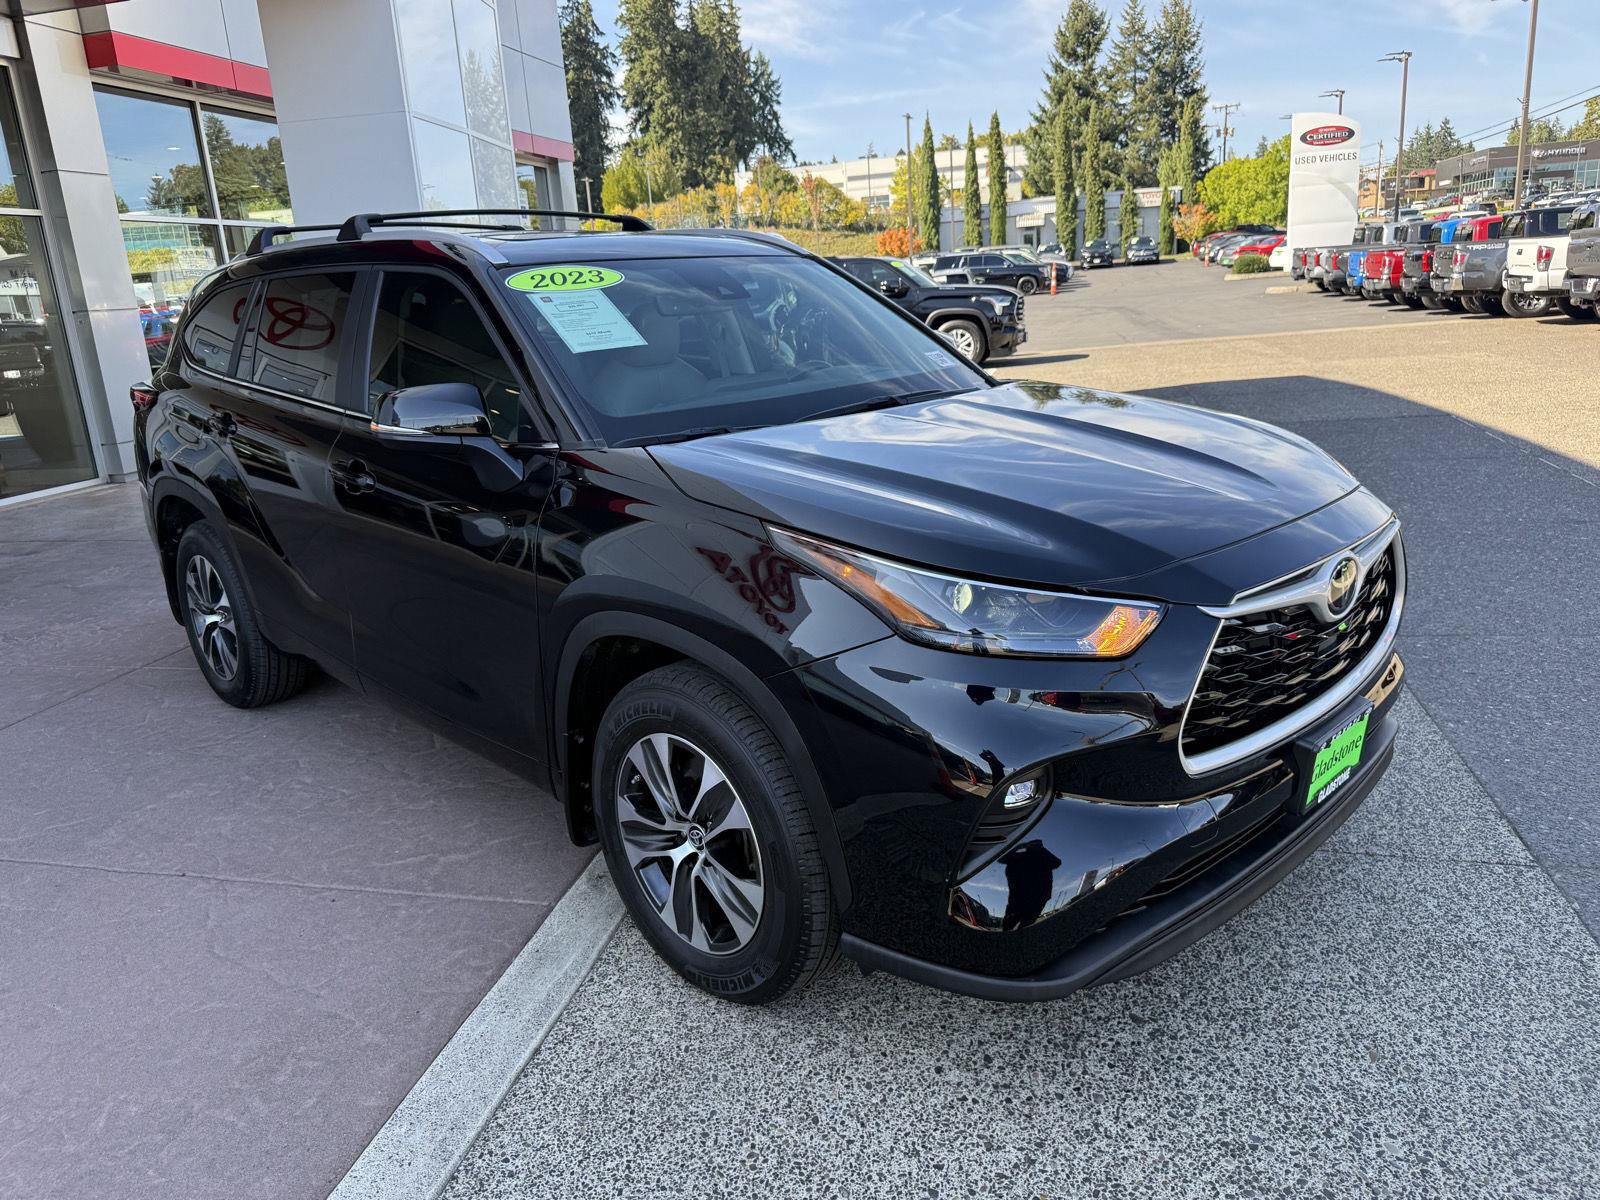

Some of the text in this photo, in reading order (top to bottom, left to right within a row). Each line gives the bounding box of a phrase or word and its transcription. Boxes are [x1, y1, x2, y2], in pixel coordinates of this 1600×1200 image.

[1306, 131, 1349, 141] CERTIFIED
[1547, 143, 1587, 156] HYUNDAI
[1295, 151, 1358, 165] USED VEHICLES
[531, 270, 605, 290] 2023
